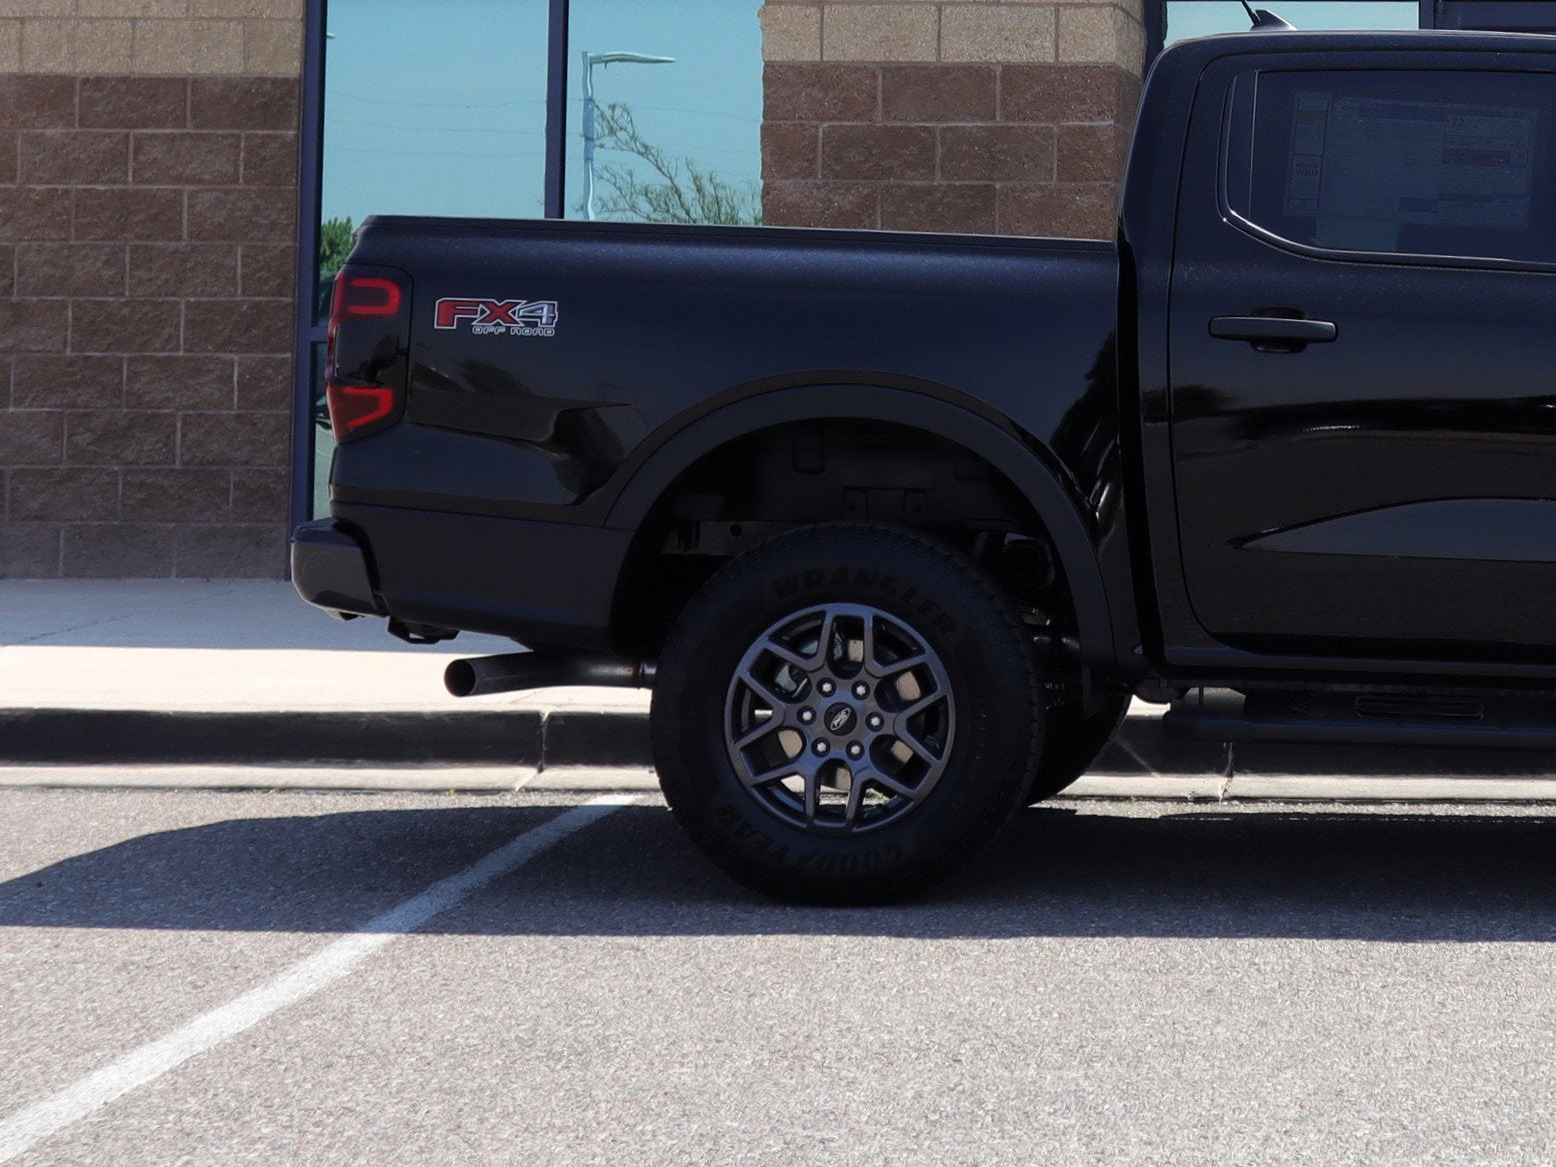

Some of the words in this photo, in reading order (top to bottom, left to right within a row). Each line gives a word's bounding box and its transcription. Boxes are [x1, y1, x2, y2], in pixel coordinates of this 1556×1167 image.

[434, 297, 558, 329] FX4
[472, 325, 506, 335] OFF
[509, 327, 555, 336] ROAD
[771, 567, 958, 636] WRANGLER
